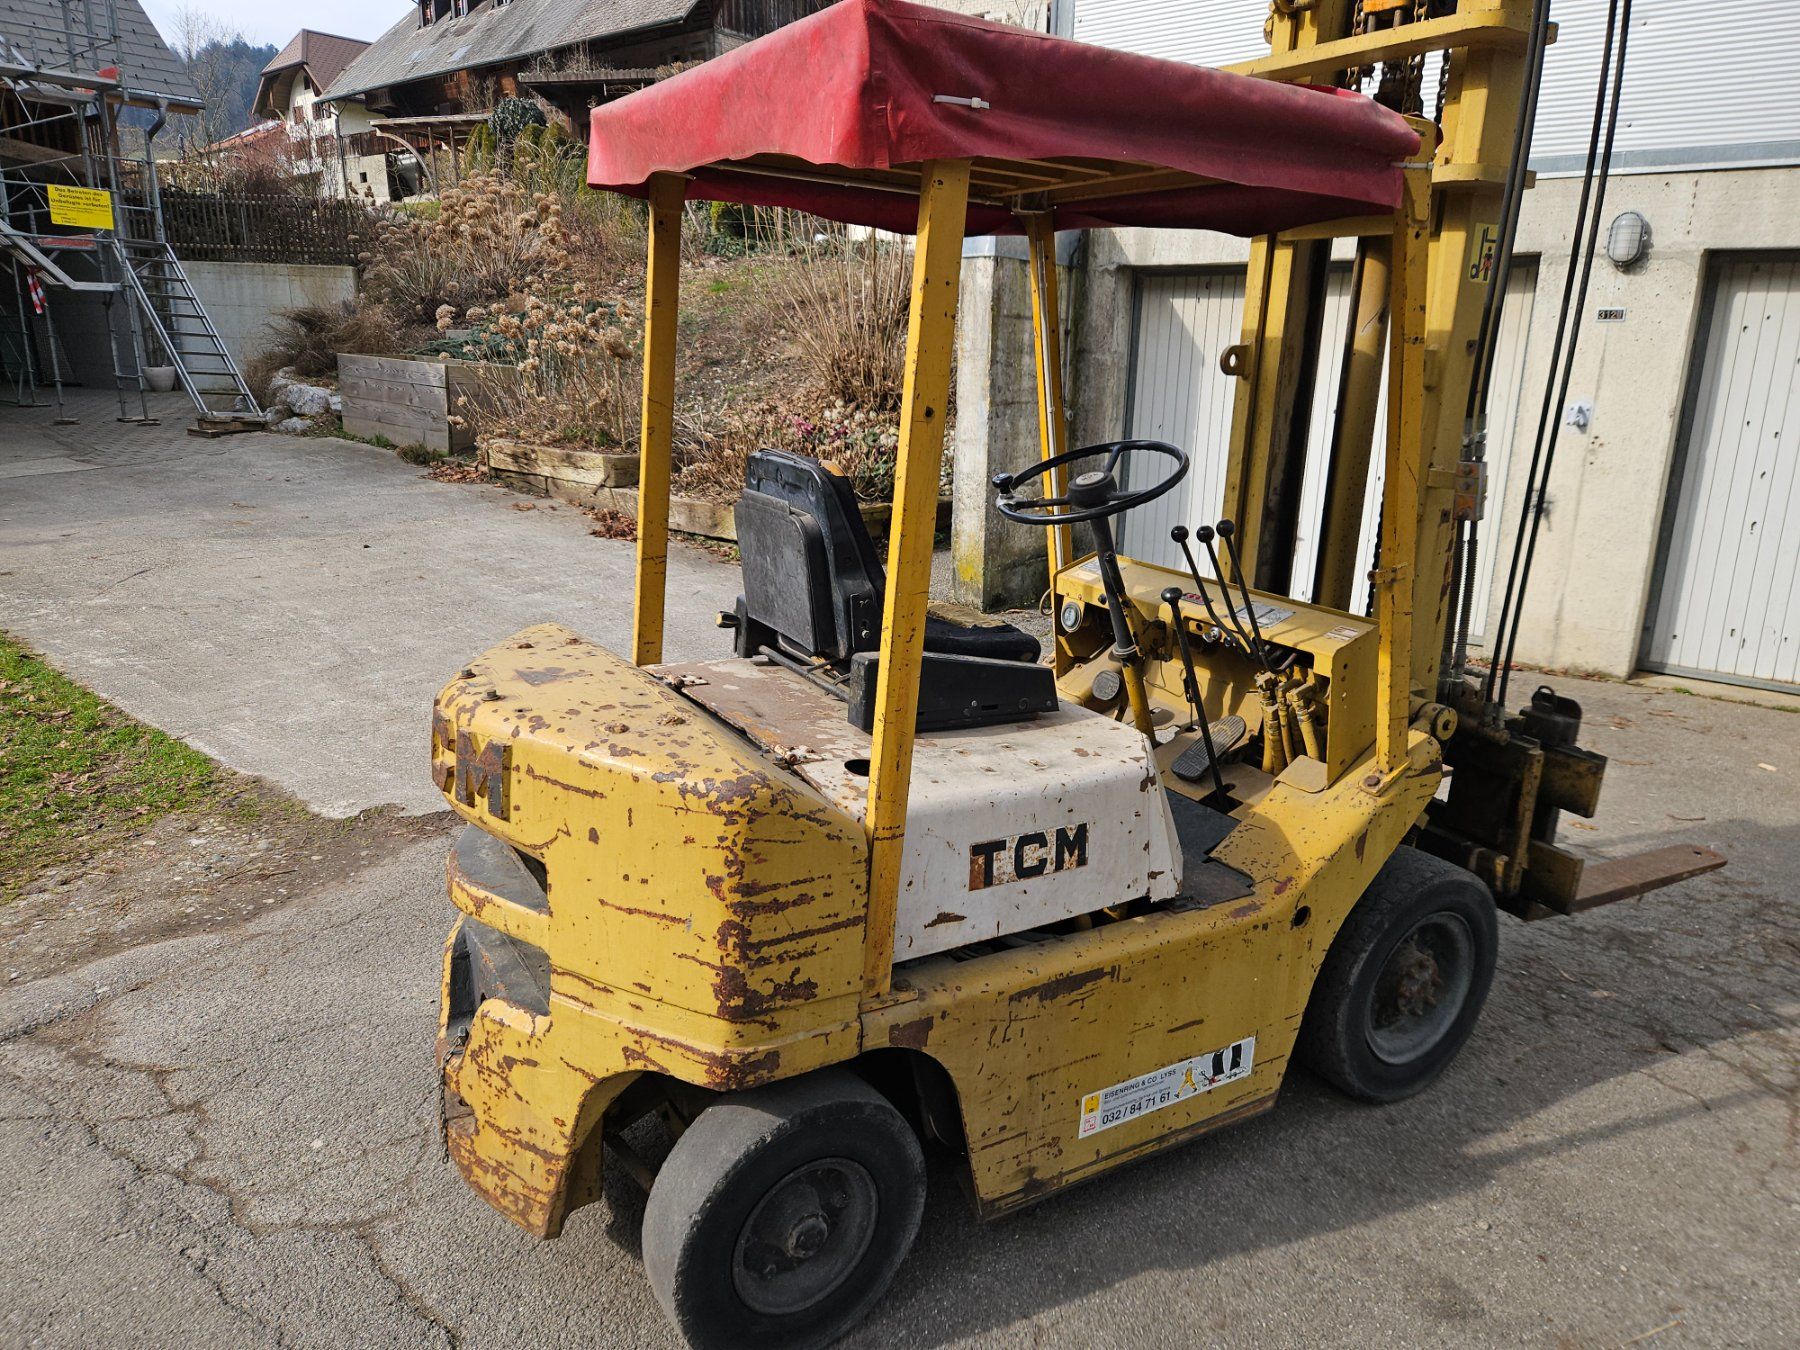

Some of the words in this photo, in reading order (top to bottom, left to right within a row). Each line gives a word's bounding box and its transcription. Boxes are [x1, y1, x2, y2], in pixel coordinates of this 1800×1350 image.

[971, 822, 1088, 887] TCM
[1104, 1081, 1140, 1100] EISENRING
[1160, 1069, 1177, 1080] LYSS
[1145, 1096, 1156, 1109] 71
[1160, 1091, 1171, 1103] 61
